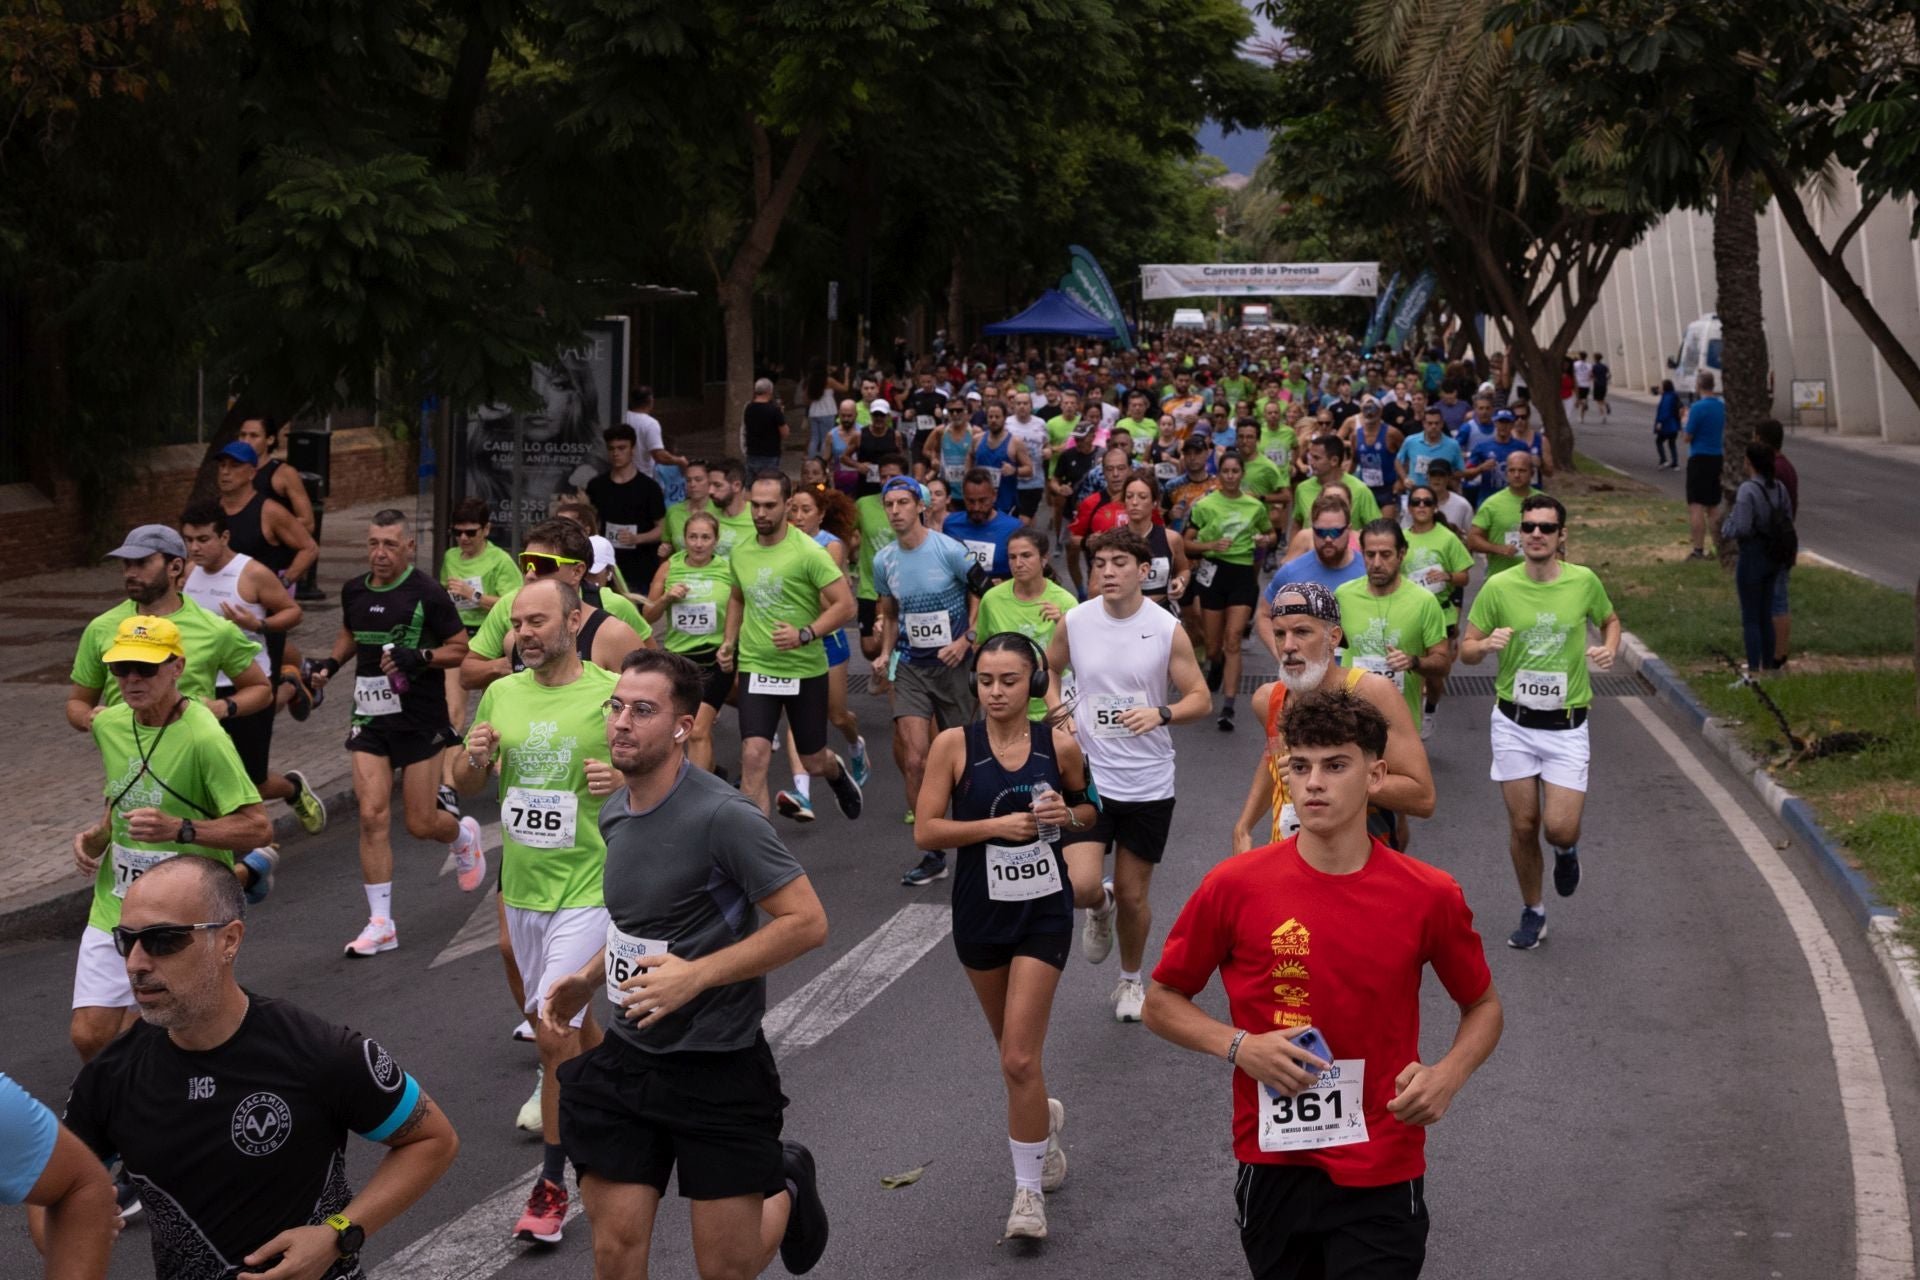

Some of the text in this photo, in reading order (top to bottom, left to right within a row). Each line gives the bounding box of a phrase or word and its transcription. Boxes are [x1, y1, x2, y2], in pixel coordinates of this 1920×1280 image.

[1203, 266, 1319, 276] Carrera de la Prensa
[544, 442, 592, 454] GLOSSY
[526, 454, 582, 465] ANTI-FRIZZ
[678, 614, 708, 625] 275
[911, 625, 943, 637] 504
[357, 688, 393, 702] 1116
[1519, 683, 1560, 696] 1094
[510, 807, 562, 831] 786
[993, 859, 1050, 881] 1090
[1272, 1089, 1343, 1125] 361
[235, 1095, 289, 1137] TRAZACAMINOS
[245, 1140, 278, 1153] CLUB
